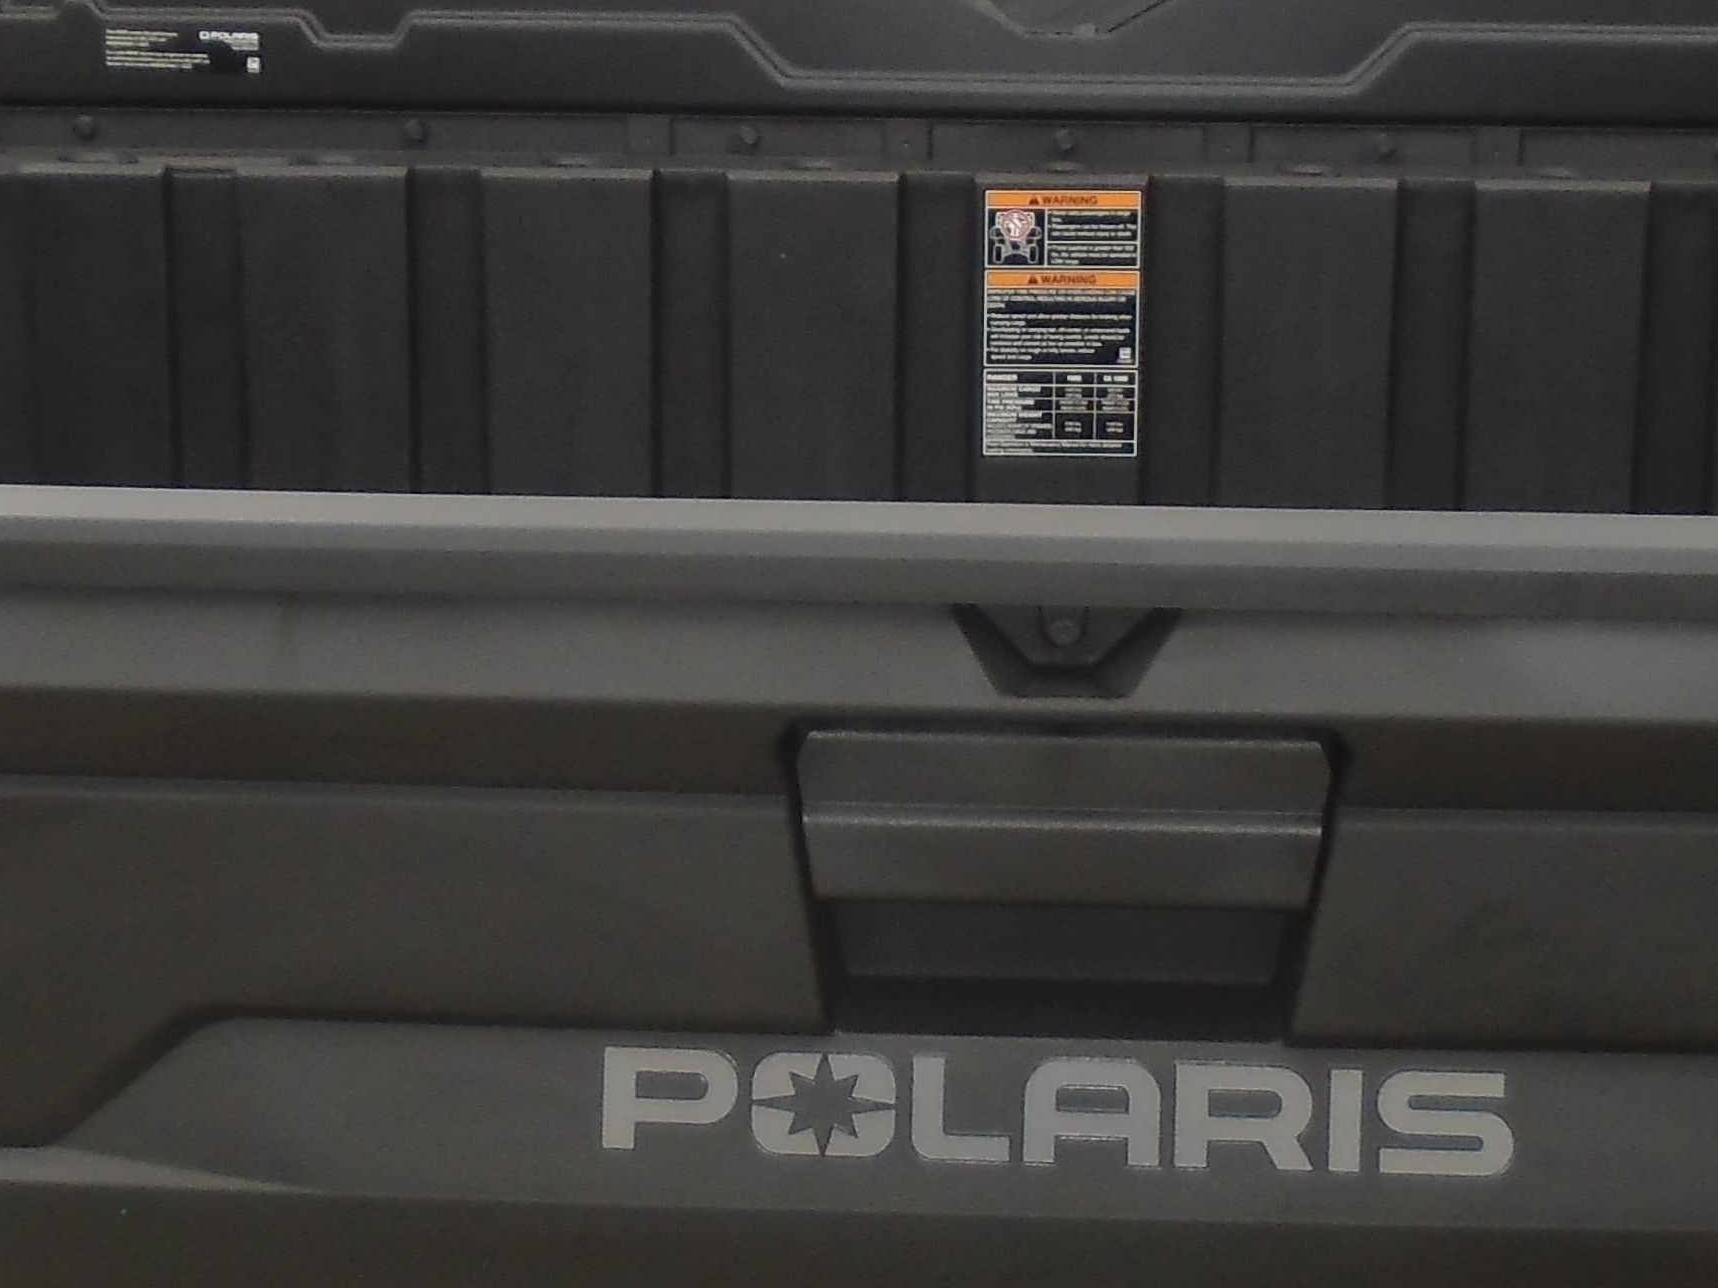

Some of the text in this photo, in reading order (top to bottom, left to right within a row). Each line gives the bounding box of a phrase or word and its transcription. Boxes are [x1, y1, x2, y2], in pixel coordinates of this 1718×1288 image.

[1042, 195, 1098, 205] WARNING
[1040, 274, 1097, 284] WARNING
[600, 1045, 1515, 1177] POLARIS
